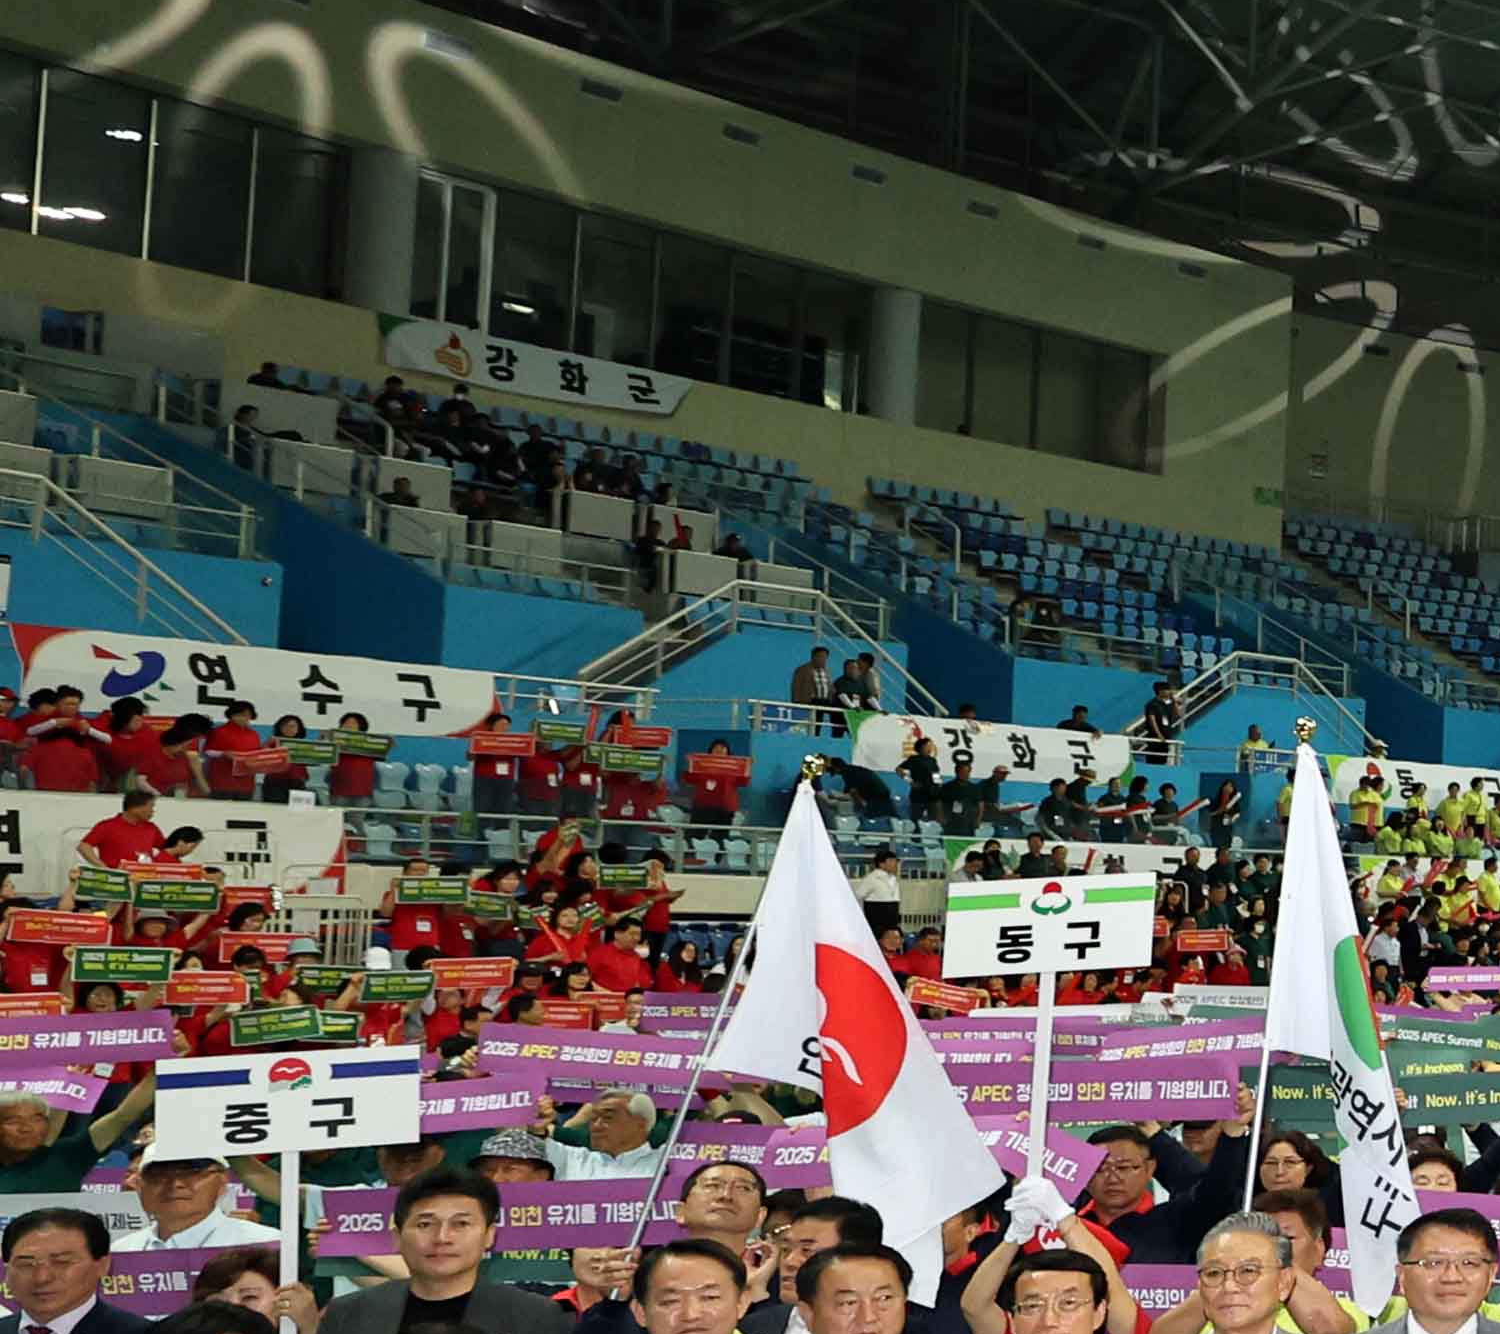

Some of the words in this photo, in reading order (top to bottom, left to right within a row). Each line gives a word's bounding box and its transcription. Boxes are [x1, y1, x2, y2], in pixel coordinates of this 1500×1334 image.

[485, 343, 662, 403] 강화군
[188, 653, 442, 722] 연수구
[942, 728, 1095, 776] 강화군
[996, 921, 1101, 964] 동구
[34, 1028, 82, 1048] 유치를
[87, 1025, 168, 1047] 기원합니다.
[223, 1096, 355, 1144] 중구
[1466, 1090, 1487, 1105] it's
